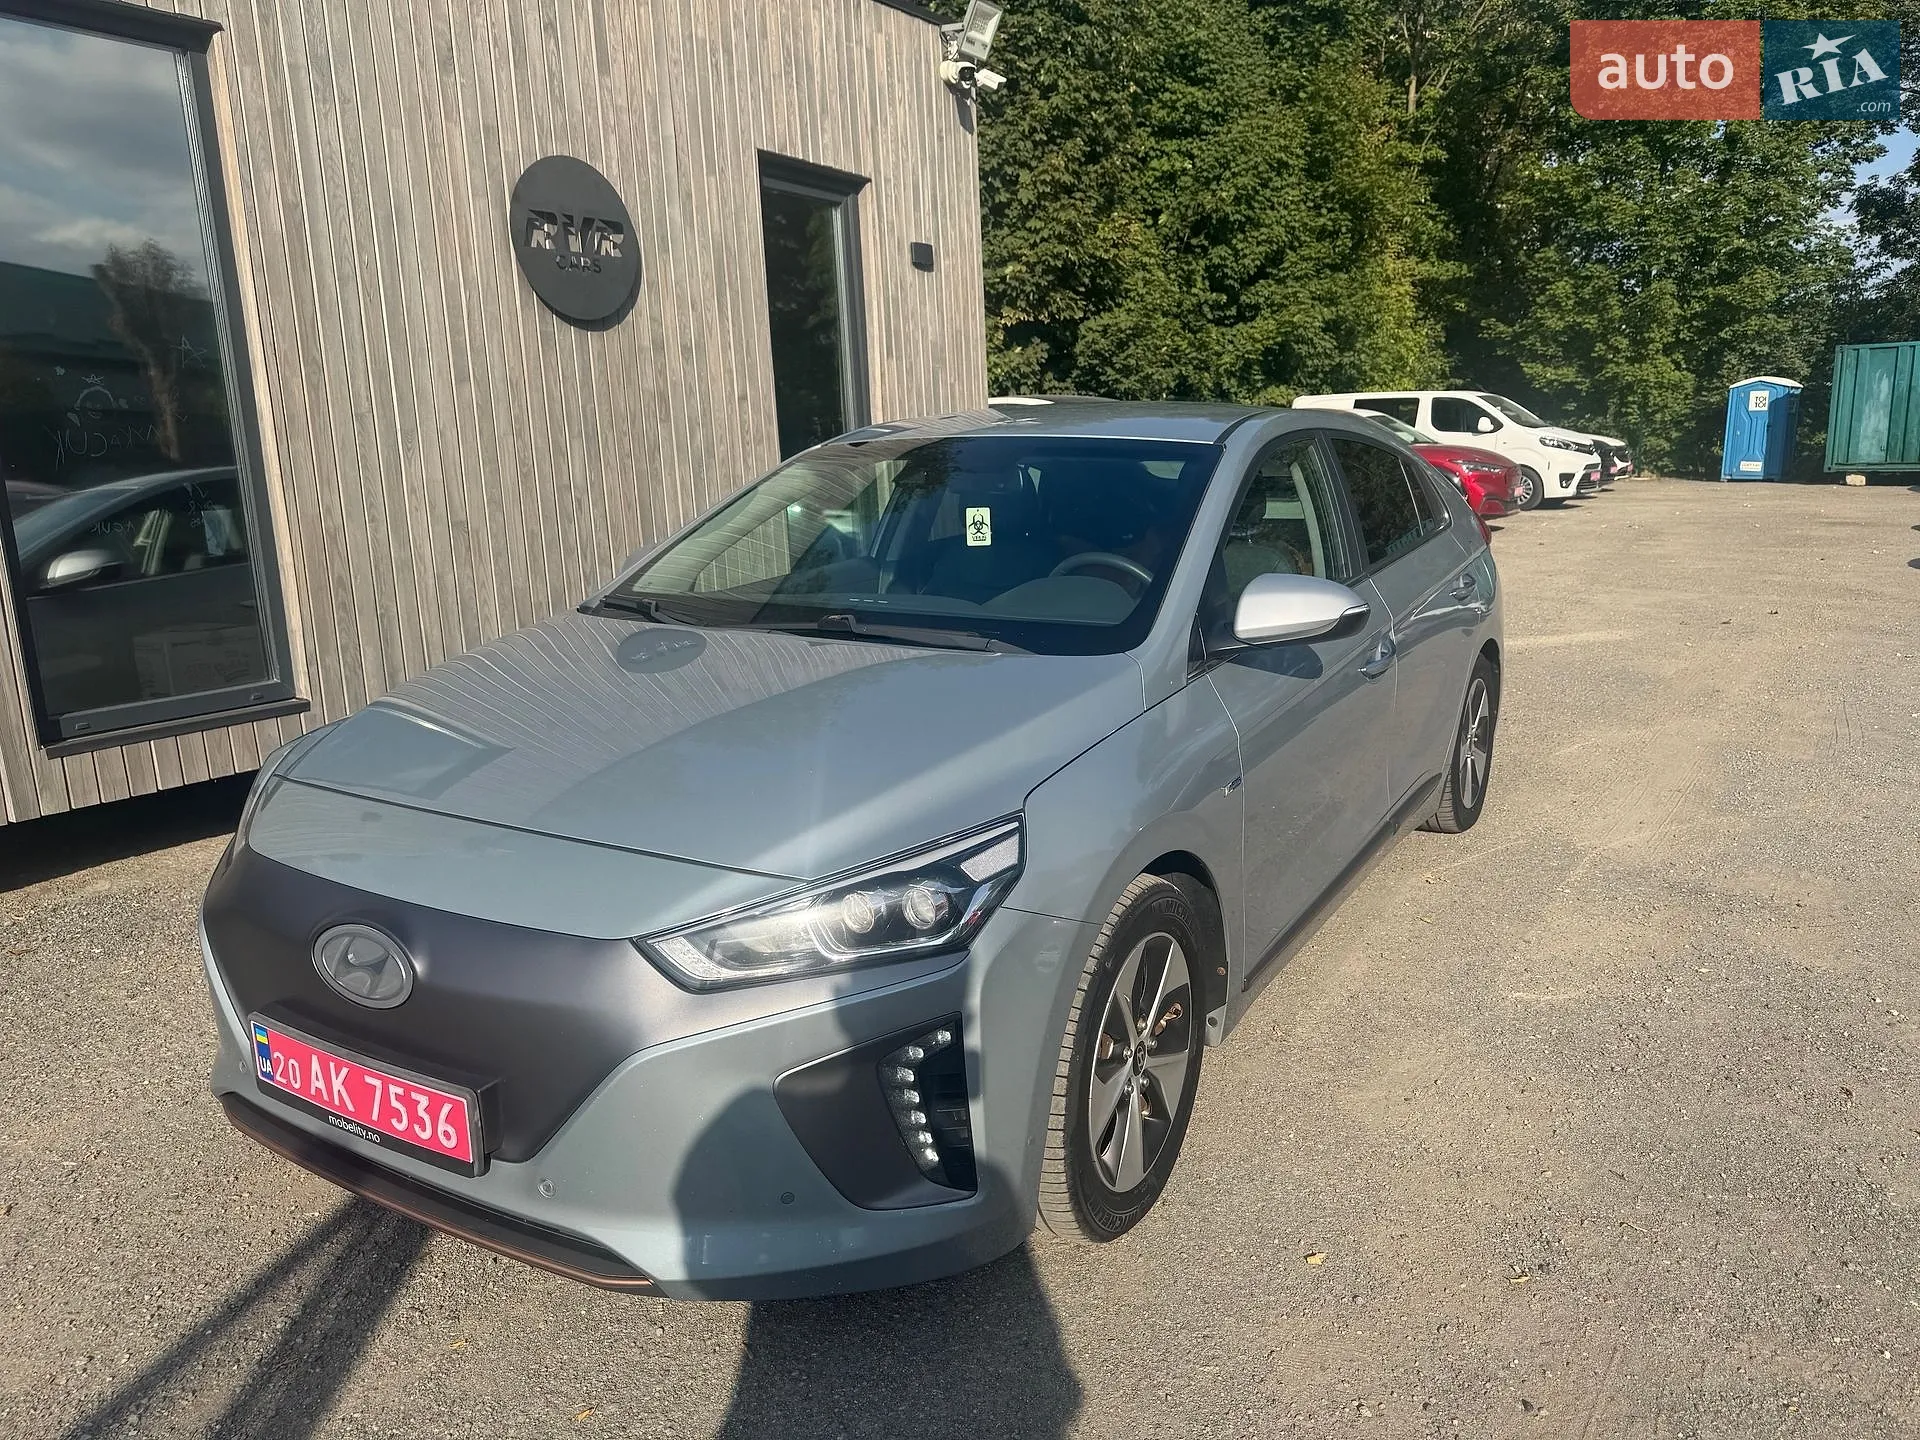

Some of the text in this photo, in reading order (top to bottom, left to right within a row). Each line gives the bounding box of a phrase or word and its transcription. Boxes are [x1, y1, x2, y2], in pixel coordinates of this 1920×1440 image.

[555, 254, 602, 273] CARS
[259, 1056, 273, 1076] UA
[273, 1051, 459, 1149] 20 AK 7536
[328, 1114, 381, 1143] mobelity.no
